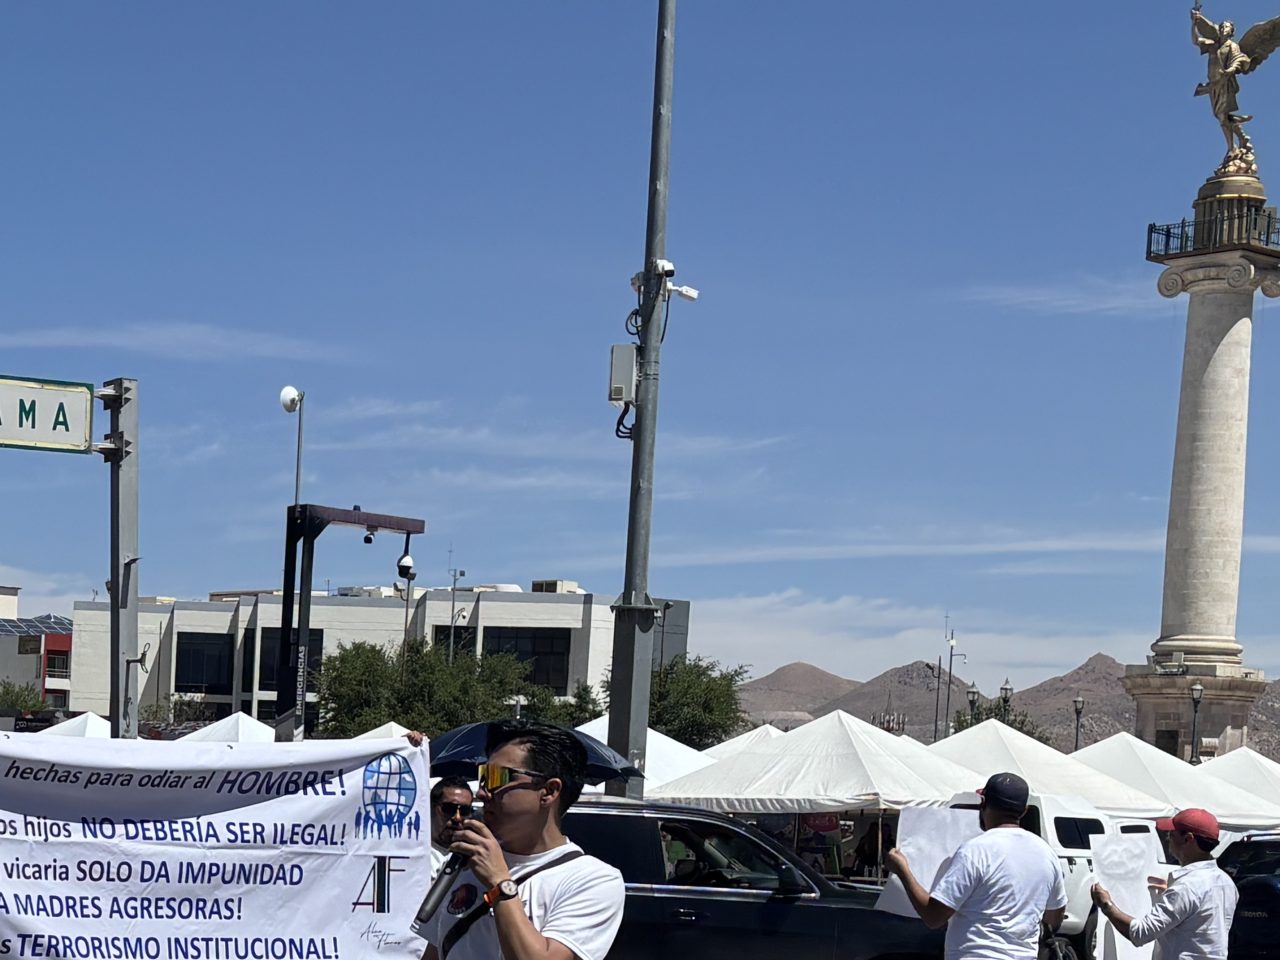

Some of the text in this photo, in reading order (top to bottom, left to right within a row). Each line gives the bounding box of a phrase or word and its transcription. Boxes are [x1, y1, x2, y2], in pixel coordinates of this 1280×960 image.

[295, 645, 306, 716] EMERGENCIAS
[4, 760, 81, 785] hechas
[84, 771, 133, 790] para
[137, 769, 192, 790] odiar
[194, 770, 216, 789] al
[217, 769, 347, 797] HOMBRE!
[23, 815, 73, 843] hijos
[81, 817, 116, 840] NO
[124, 815, 221, 844] DEBERÍA
[226, 821, 266, 845] SER
[272, 822, 346, 847] ILEGAL!
[4, 854, 70, 882] vicaria
[76, 859, 133, 883] SOLO
[140, 860, 171, 883] DA
[178, 860, 304, 886] IMPUNIDAD
[14, 893, 103, 919] MADRES
[109, 896, 243, 921] AGRESORAS!
[17, 932, 160, 960] TERRORISMO
[167, 936, 340, 960] INSTITUCIONAL!
